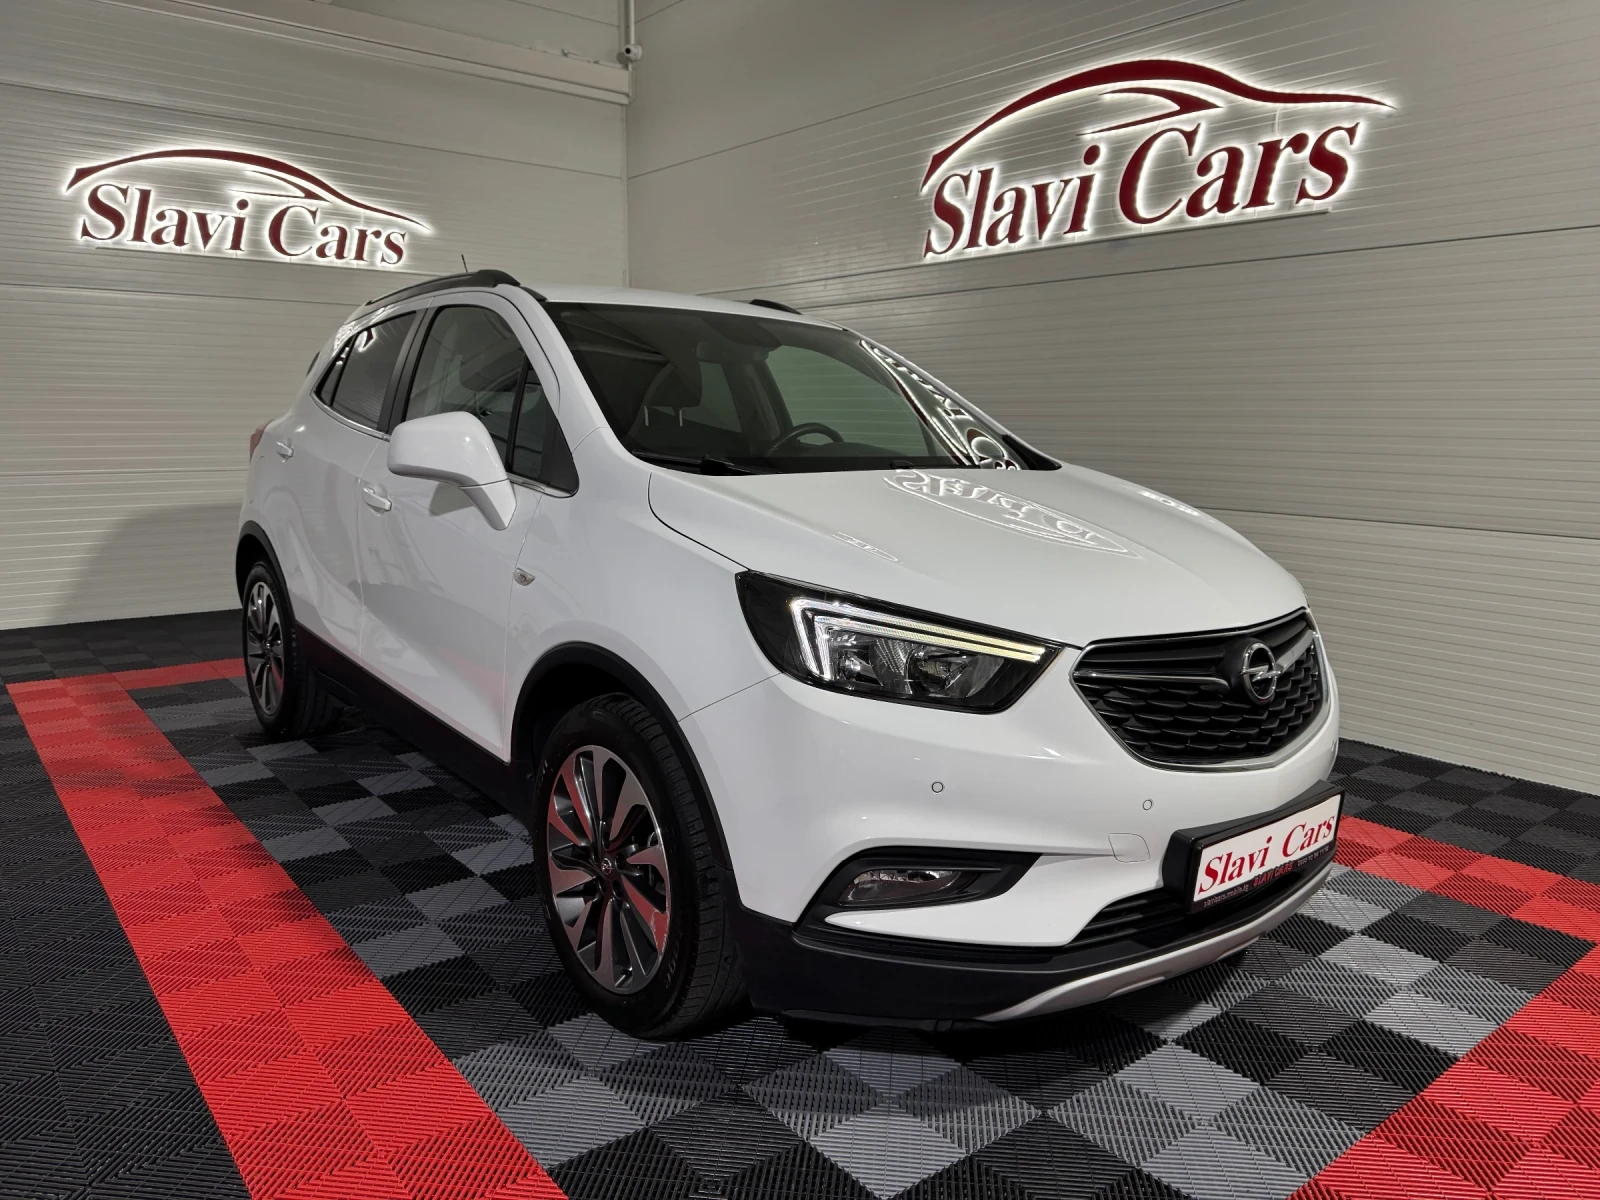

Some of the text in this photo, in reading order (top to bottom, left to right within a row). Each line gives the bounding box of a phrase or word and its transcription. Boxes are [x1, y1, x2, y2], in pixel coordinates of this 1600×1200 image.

[80, 184, 407, 265] Slavi Cars
[924, 121, 1361, 258] Slavi Cars
[1197, 836, 1272, 895] Slavi
[1281, 814, 1335, 858] Cars
